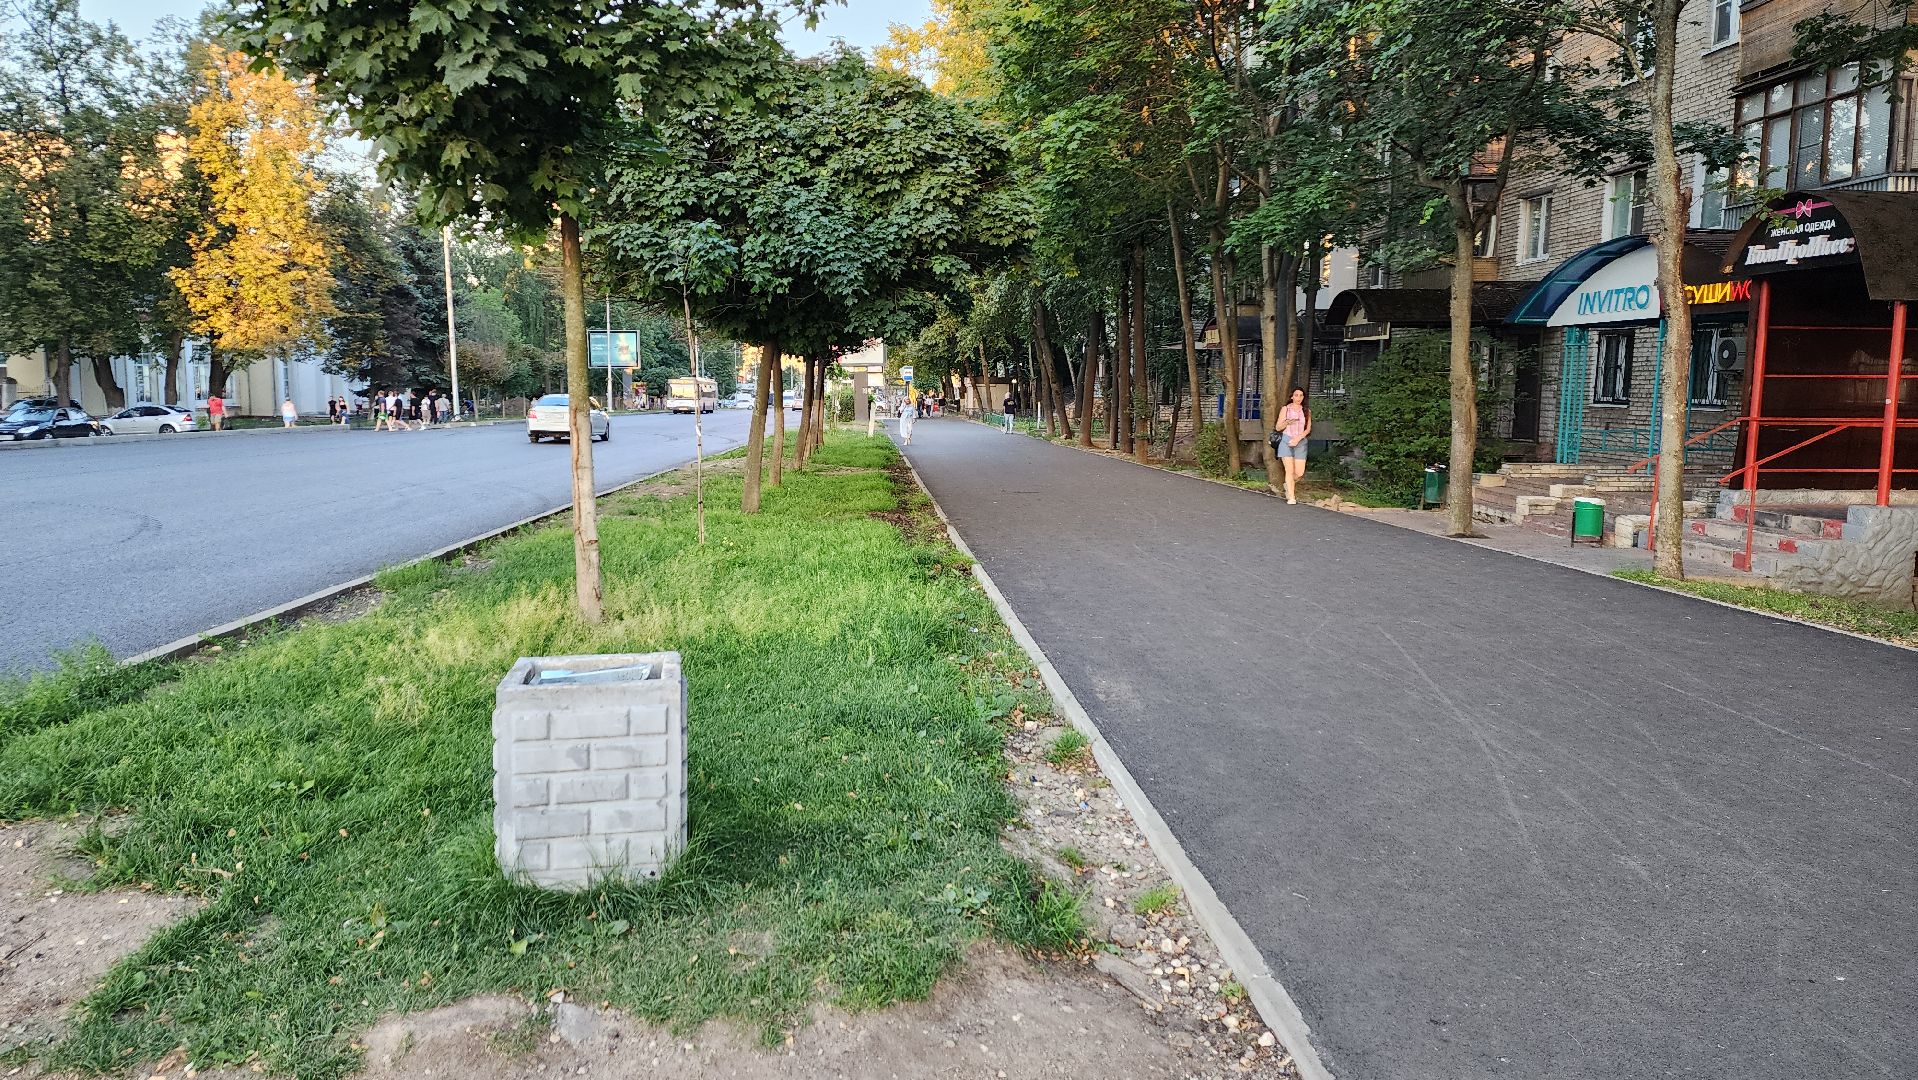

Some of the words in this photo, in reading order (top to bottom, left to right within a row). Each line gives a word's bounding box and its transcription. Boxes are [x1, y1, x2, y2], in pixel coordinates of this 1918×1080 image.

[1770, 223, 1803, 238] ЖЕНСКАЯ
[1804, 219, 1836, 233] ОДЕЖДА
[1577, 284, 1651, 316] INVITRO
